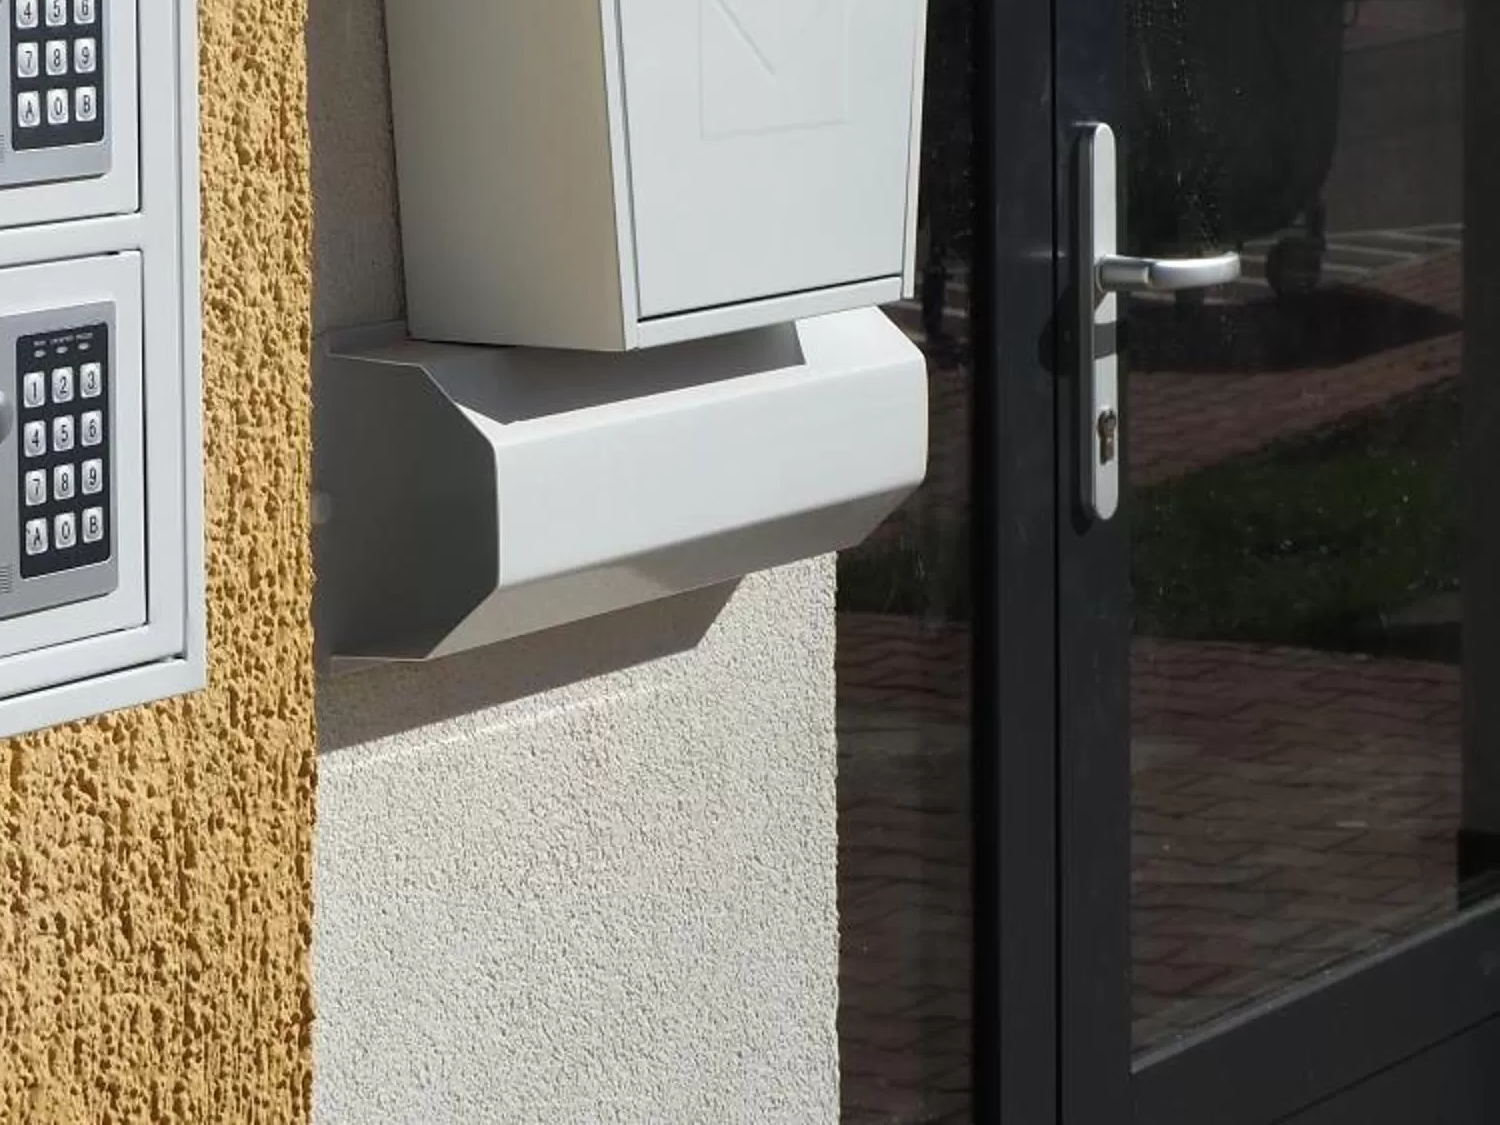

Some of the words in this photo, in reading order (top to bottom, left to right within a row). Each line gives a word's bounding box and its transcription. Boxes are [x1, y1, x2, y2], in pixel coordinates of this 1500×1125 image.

[22, 2, 33, 19] 4
[52, 0, 62, 18] 5
[24, 51, 34, 69] 7
[52, 49, 62, 67] 8
[80, 47, 90, 65] 9
[24, 101, 34, 119] A
[82, 95, 91, 113] B
[58, 376, 68, 395] 2
[87, 371, 96, 389] 3
[30, 429, 40, 447] 4
[60, 424, 70, 442] 5
[88, 419, 97, 437] 6
[31, 478, 42, 496] 7
[60, 473, 70, 491] 8
[88, 467, 98, 486] 9
[32, 528, 42, 546] A
[89, 516, 98, 534] B
